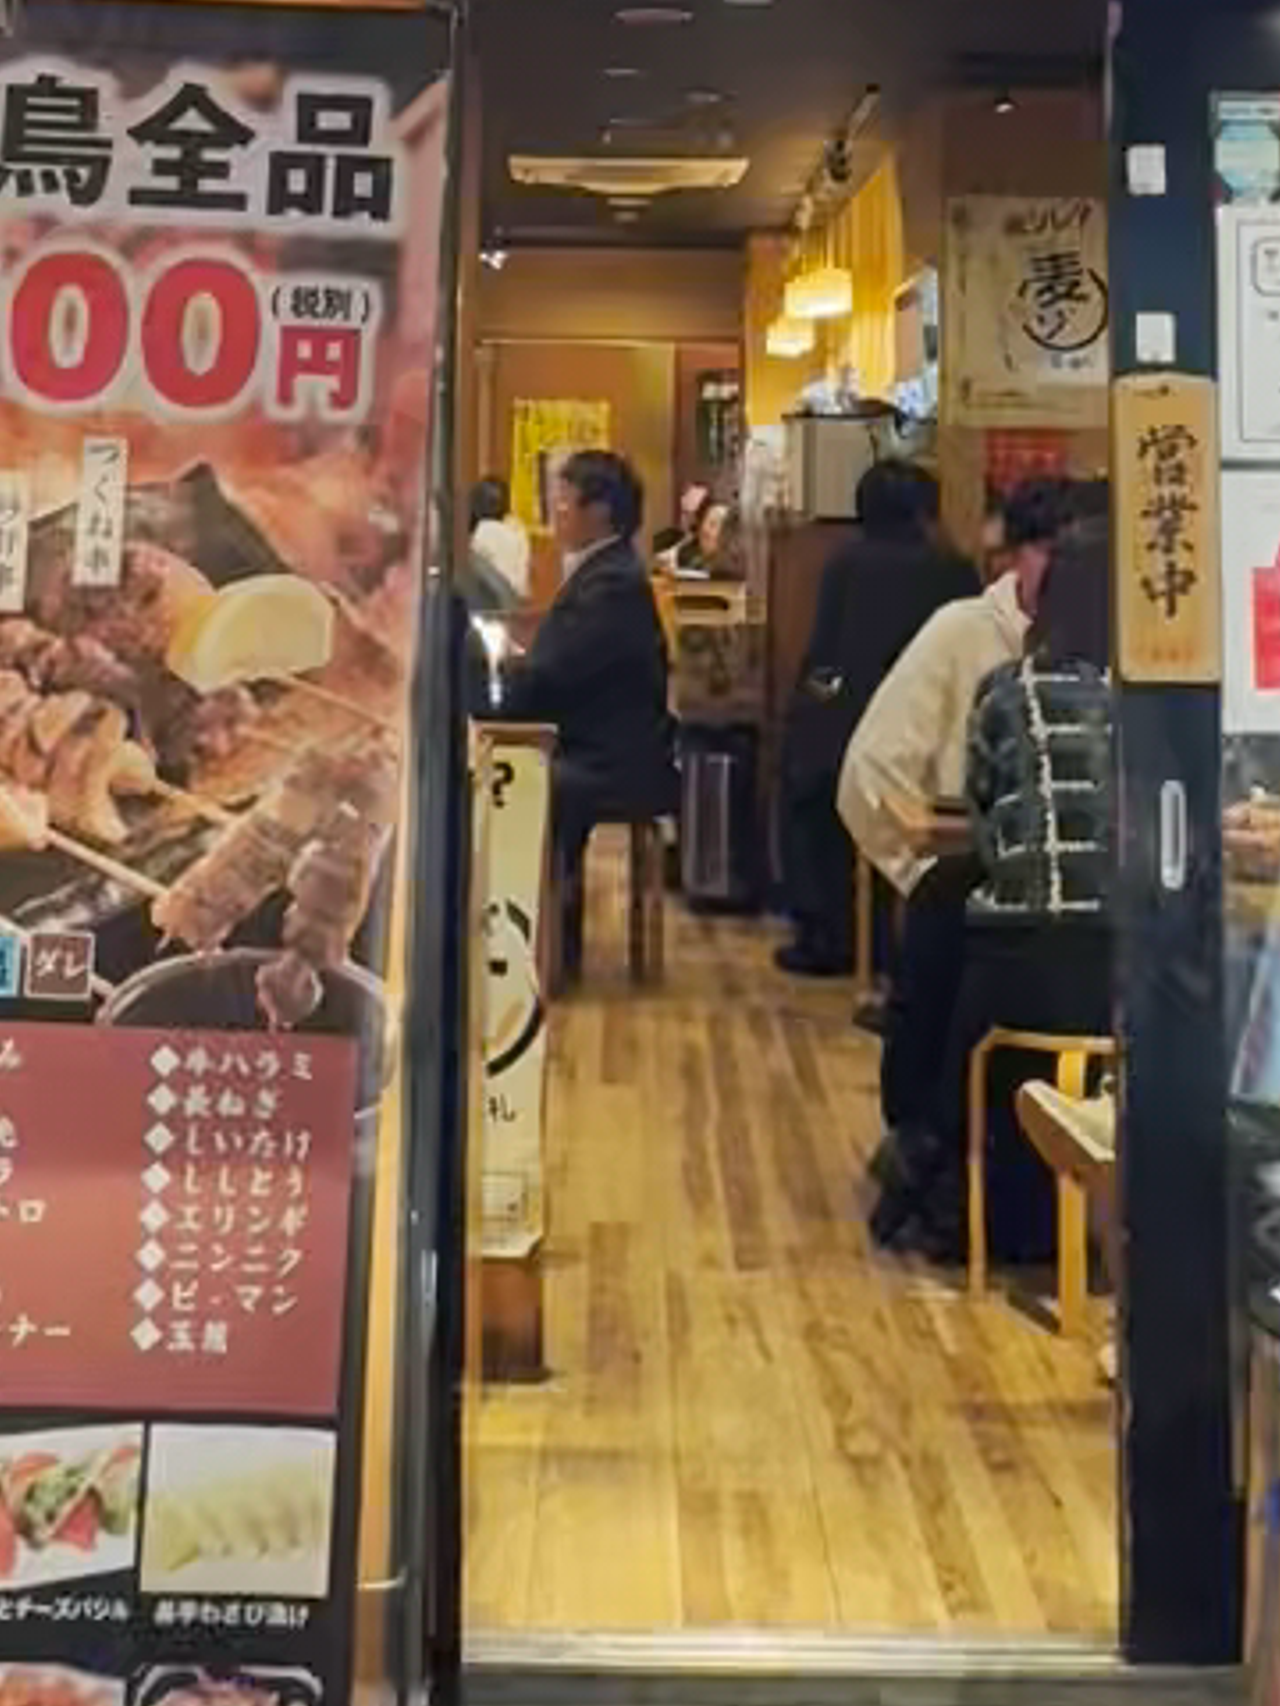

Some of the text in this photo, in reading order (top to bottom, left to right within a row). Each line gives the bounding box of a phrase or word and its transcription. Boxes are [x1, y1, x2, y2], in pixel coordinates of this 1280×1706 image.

[83, 443, 121, 574] つくね串
[1137, 424, 1200, 619] 営業中
[184, 1046, 313, 1081] 牛ハラミ
[186, 1123, 312, 1162] しいたけ
[183, 1162, 306, 1197] ししとう
[174, 1203, 308, 1238] エリンギ
[170, 1241, 303, 1278] ニンニク
